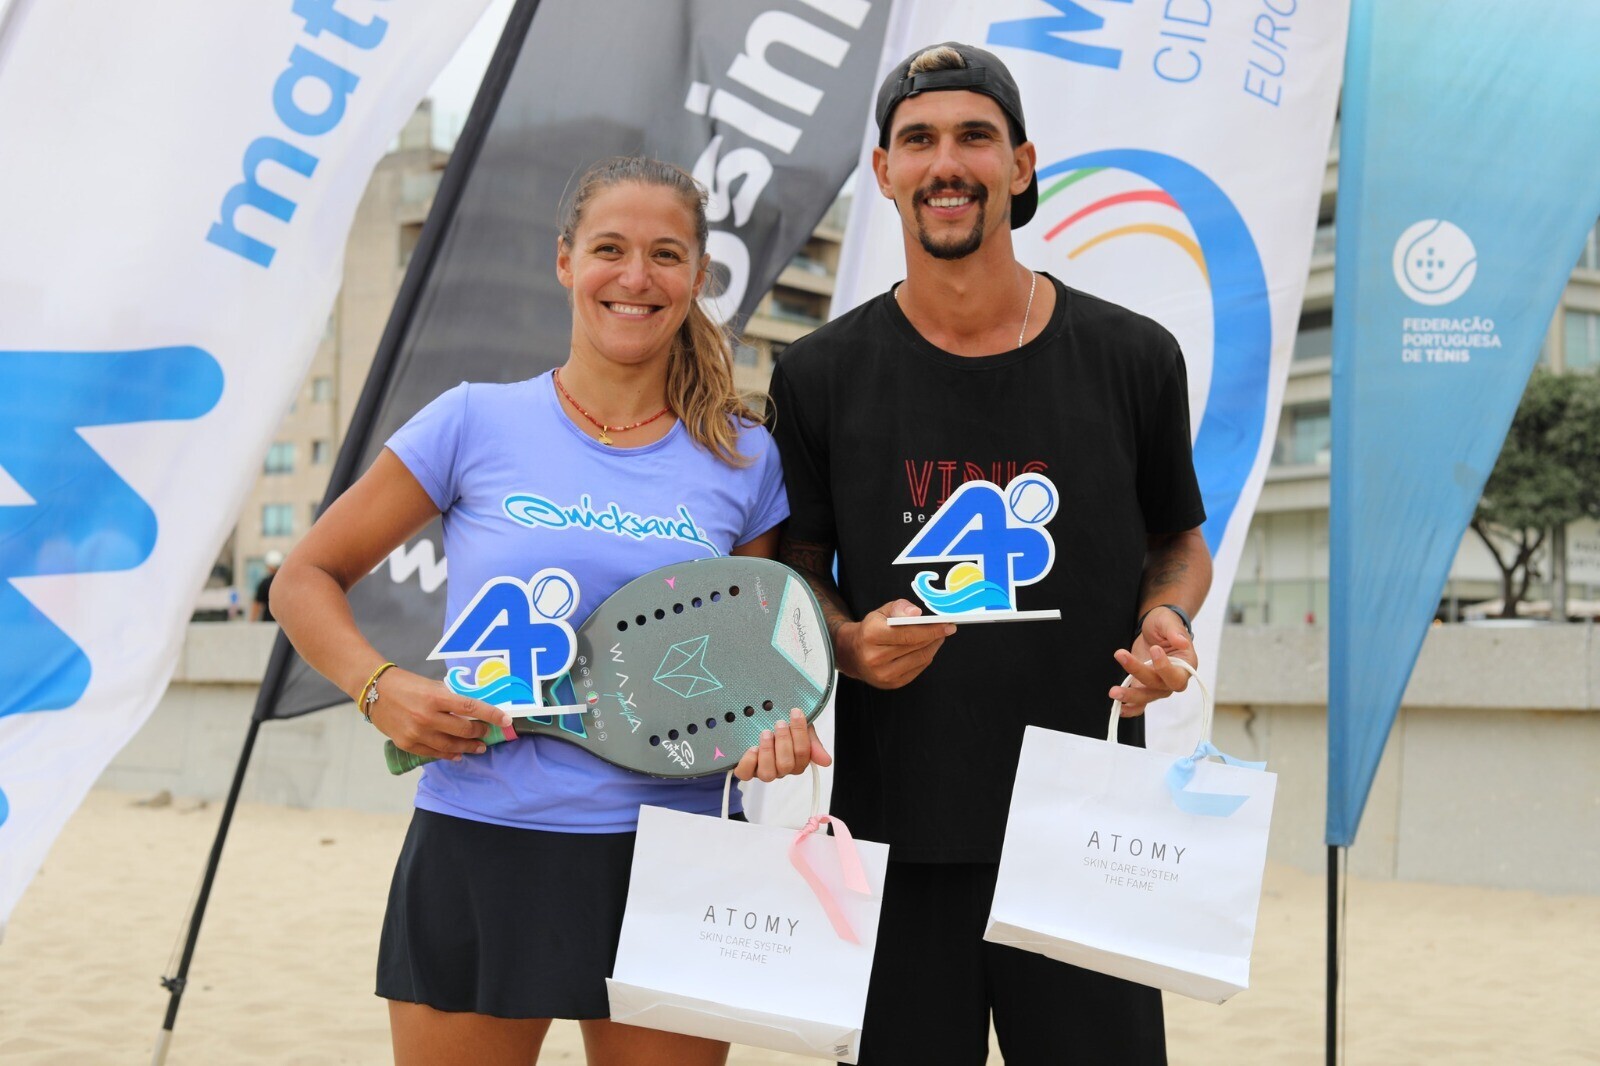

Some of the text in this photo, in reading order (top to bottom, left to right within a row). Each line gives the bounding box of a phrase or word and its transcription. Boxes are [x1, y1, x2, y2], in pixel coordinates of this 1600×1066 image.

[205, 0, 389, 269] mat
[1403, 316, 1495, 333] FEDERAÇÃO
[1402, 333, 1502, 348] PORTUGUESA
[1402, 349, 1422, 362] DE
[502, 492, 721, 558] Quicksand
[1086, 830, 1186, 864] ATOMY
[1083, 857, 1179, 882] SKIN CARE SYSTEM
[1104, 874, 1154, 892] THE FAME
[703, 905, 799, 937] ATOMY
[699, 931, 792, 954] SKIN CARE SYSTEM
[719, 947, 768, 964] THE FAME
